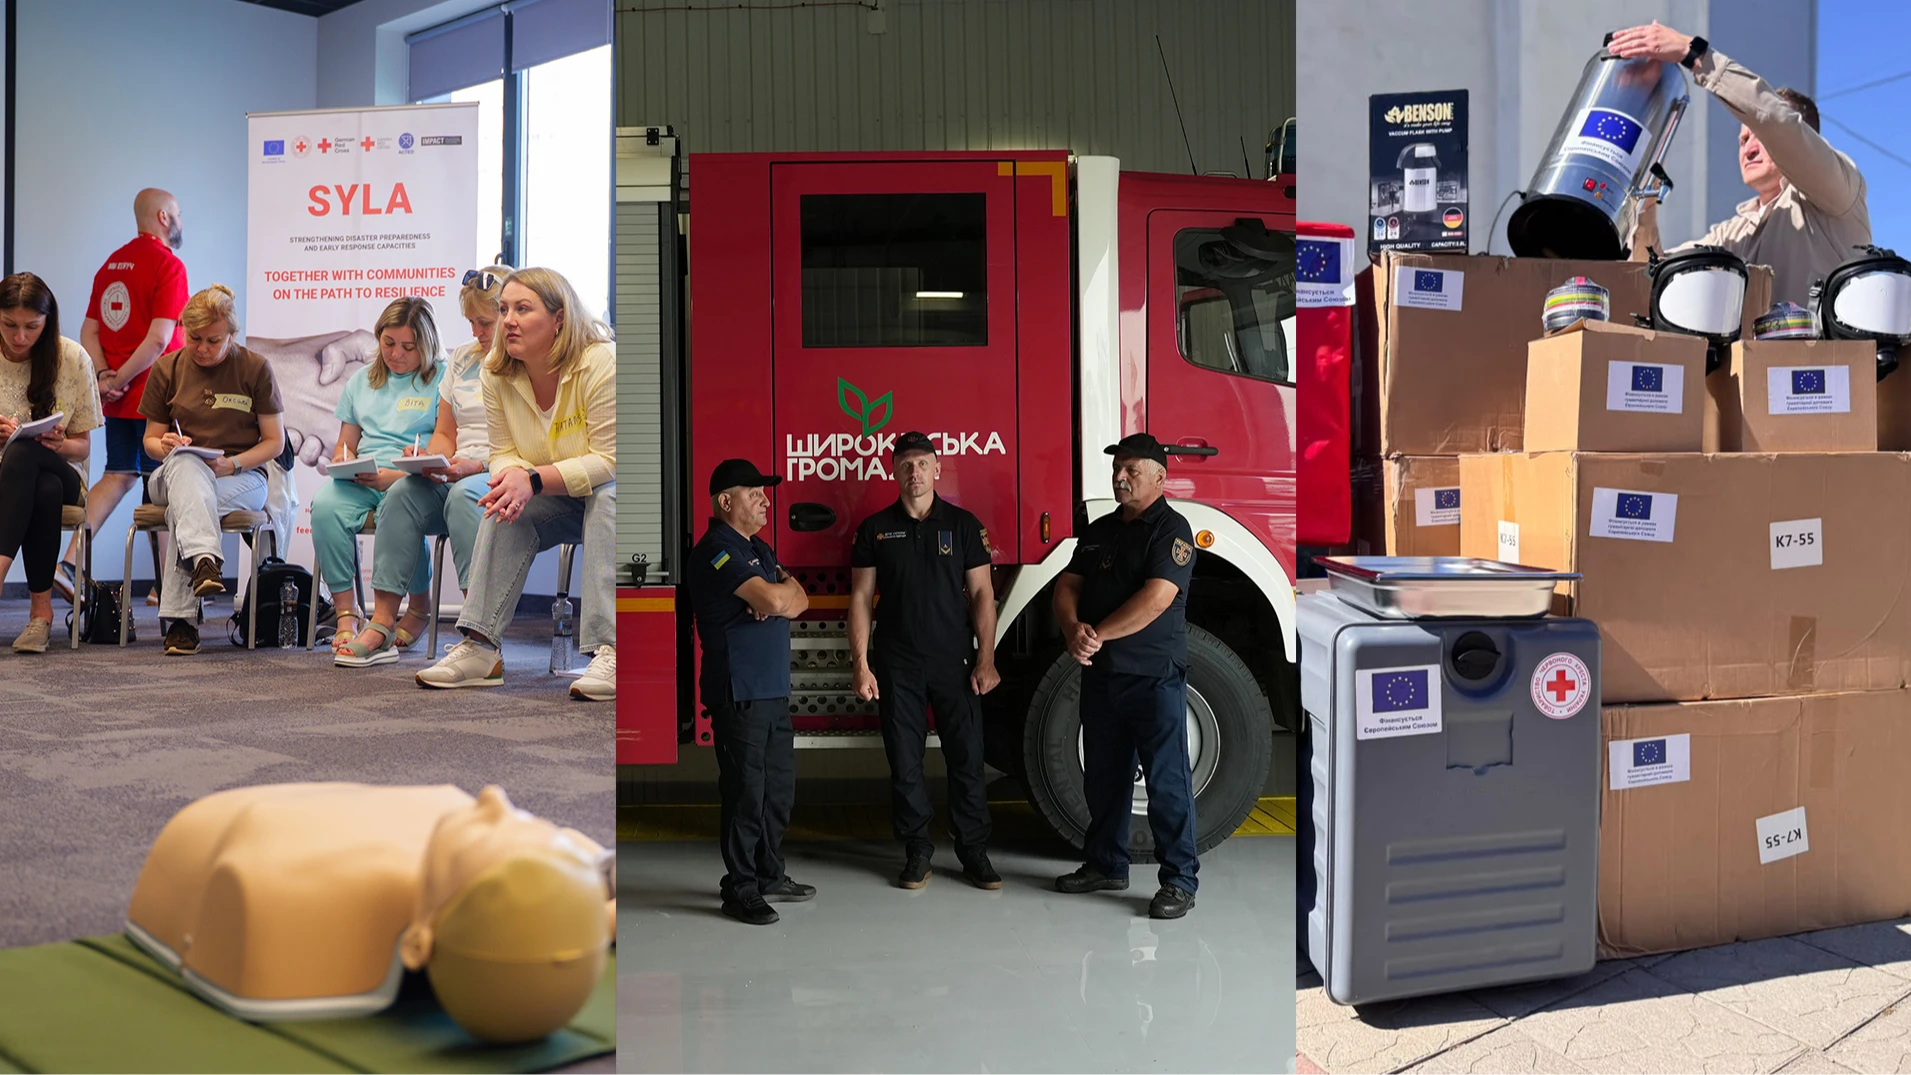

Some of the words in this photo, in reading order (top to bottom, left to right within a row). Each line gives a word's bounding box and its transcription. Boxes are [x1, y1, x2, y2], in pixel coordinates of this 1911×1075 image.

[1404, 103, 1451, 122] BENSON
[422, 137, 445, 145] IMPACT
[307, 182, 413, 217] SYLA
[289, 235, 344, 243] STRENGTHENING
[345, 234, 378, 242] DISASTER
[379, 233, 431, 241] PREPAREDNESS
[264, 270, 328, 282] TOGETHER
[331, 269, 363, 281] WITH
[366, 267, 456, 280] COMMUNITIES
[273, 288, 291, 300] ON
[294, 288, 318, 300] THE
[320, 287, 353, 299] PATH
[355, 287, 372, 299] TO
[375, 285, 446, 298] RESILIENCE
[786, 431, 1007, 457] ШИРОКСЬКА
[786, 457, 940, 482] ГРОМА
[1775, 532, 1814, 548] K7-55
[631, 553, 647, 563] G2
[1379, 716, 1422, 724] Фінансується
[1364, 725, 1411, 734] Європейським
[1412, 722, 1438, 730] Союзом
[1764, 828, 1802, 849] K7-55
